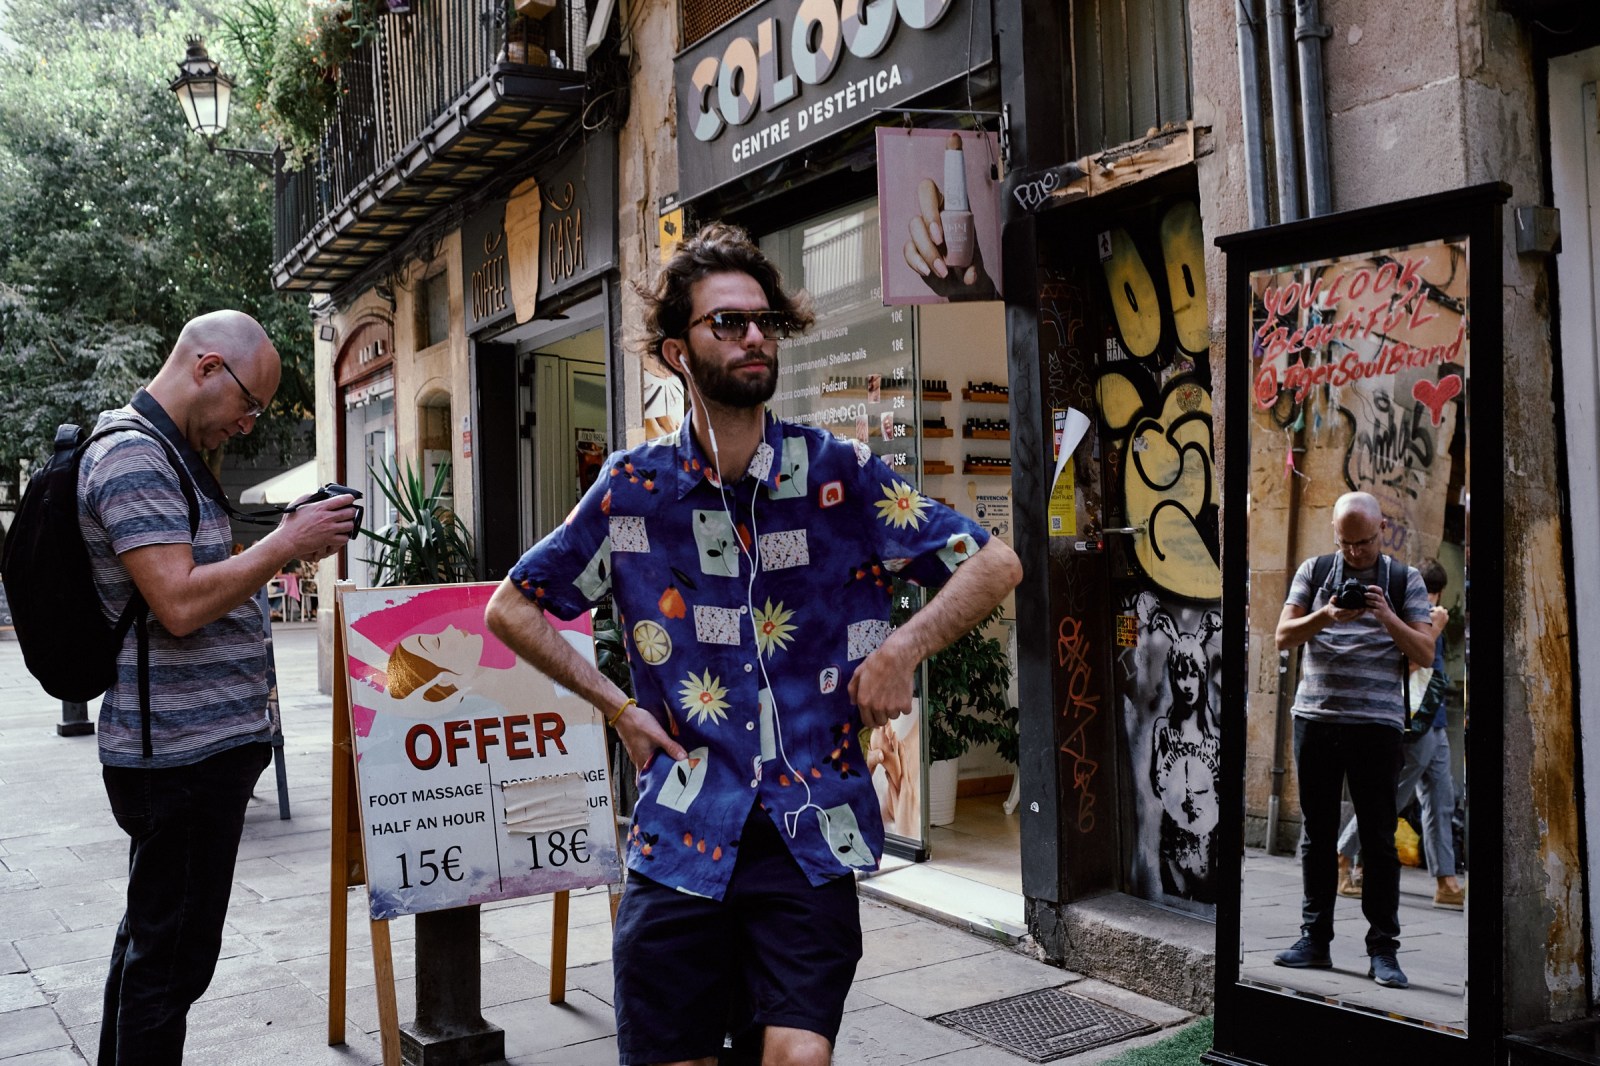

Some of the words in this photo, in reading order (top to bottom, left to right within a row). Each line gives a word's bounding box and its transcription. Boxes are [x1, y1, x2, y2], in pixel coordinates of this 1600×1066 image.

[732, 117, 790, 163] CENTRE
[798, 64, 902, 132] D'ESTÈTICA
[549, 207, 586, 284] CASA
[471, 255, 507, 322] COFFEE
[1258, 277, 1323, 337] YOU
[1325, 256, 1430, 307] LOOK
[821, 326, 848, 341] Manicure
[891, 310, 903, 324] 10€
[829, 351, 851, 365] Shellac
[851, 347, 867, 361] nails
[891, 338, 904, 352] 18€
[821, 380, 848, 393] Pedicure
[892, 367, 905, 380] 15€
[893, 395, 905, 409] 25€
[893, 424, 906, 437] 35€
[894, 453, 907, 466] 35€
[901, 596, 909, 609] 5€
[405, 712, 568, 770] OFFER
[369, 792, 408, 807] FOOT
[412, 783, 483, 802] MASSAGE
[372, 819, 412, 836] HALF
[416, 816, 438, 831] AN
[443, 810, 486, 827] HOUR
[396, 845, 465, 890] 15€
[527, 828, 591, 870] 18€
